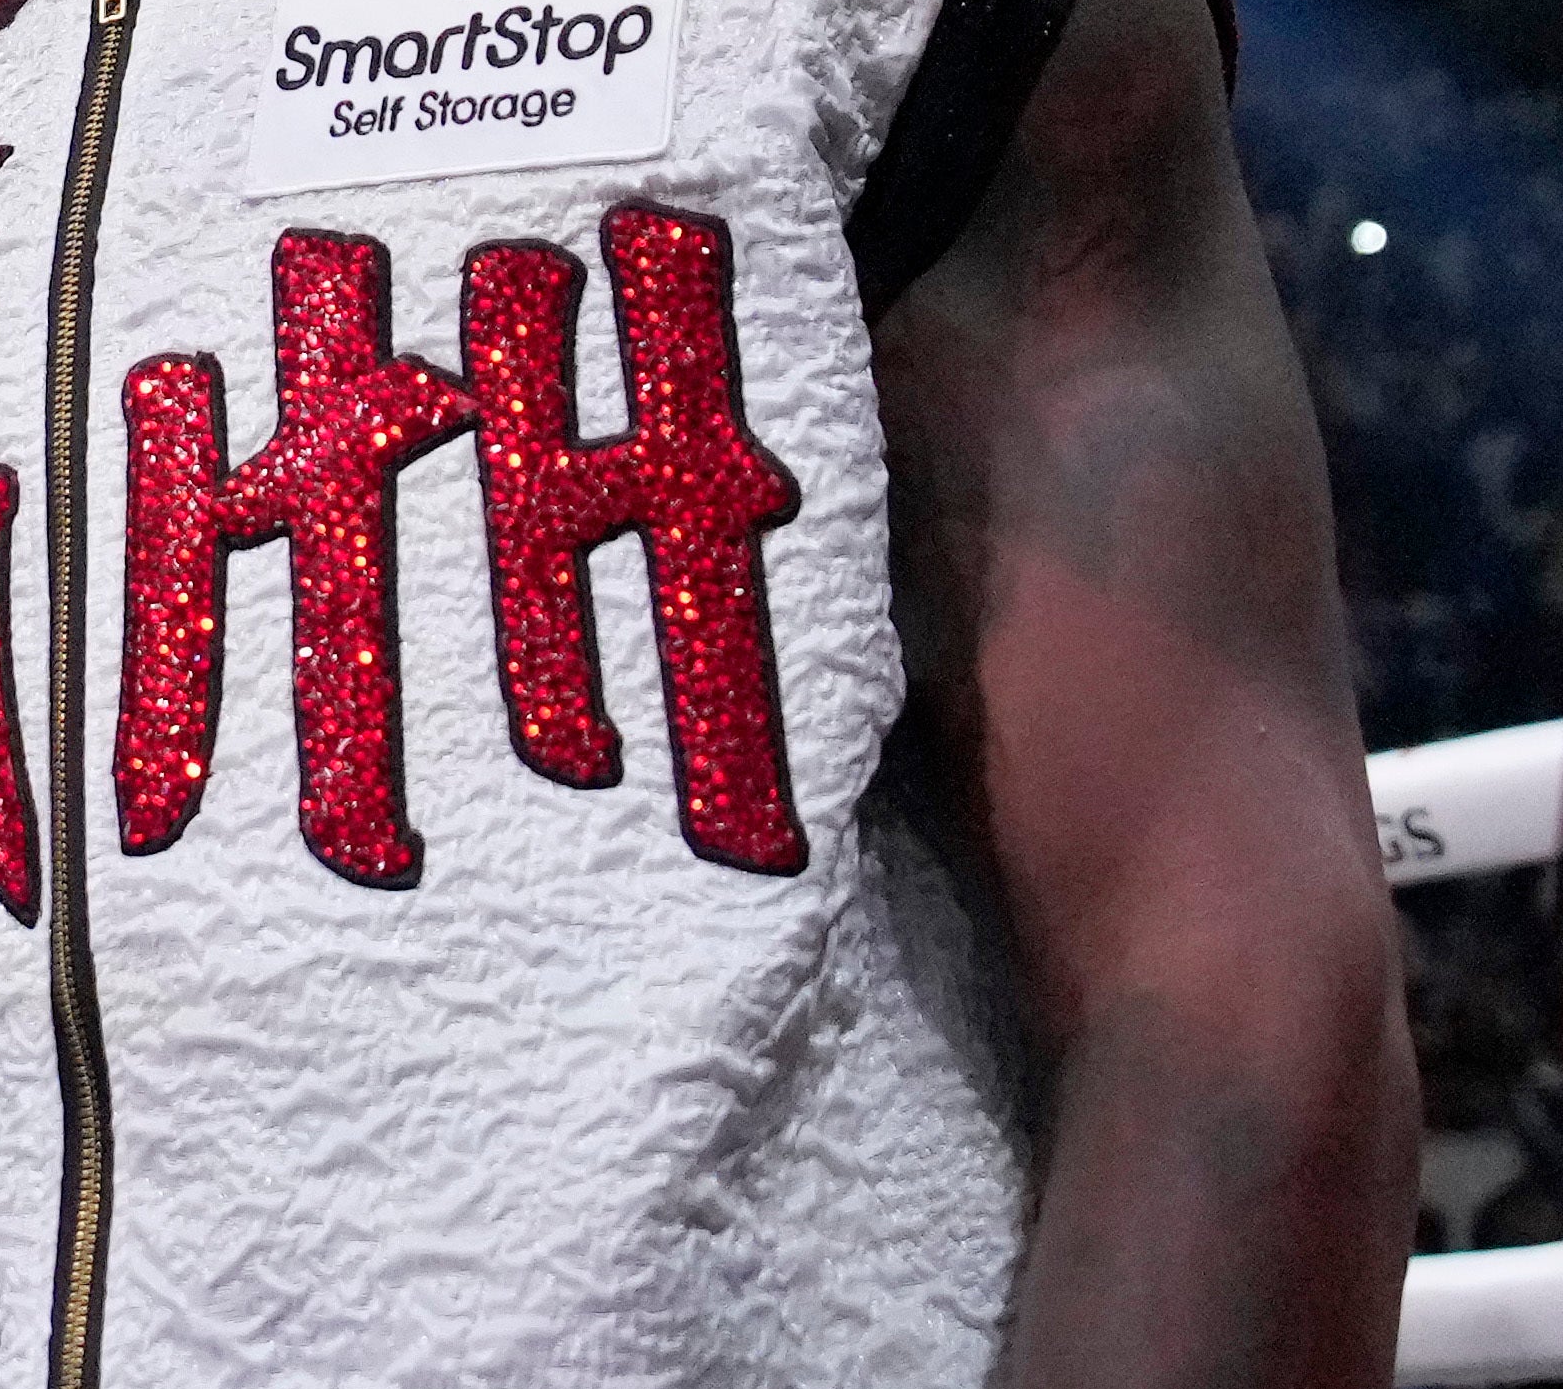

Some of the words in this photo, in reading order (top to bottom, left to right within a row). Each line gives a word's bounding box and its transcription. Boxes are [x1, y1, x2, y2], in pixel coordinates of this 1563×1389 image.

[275, 3, 653, 91] SmartStop
[330, 94, 405, 137] Self
[414, 87, 577, 132] Storage
